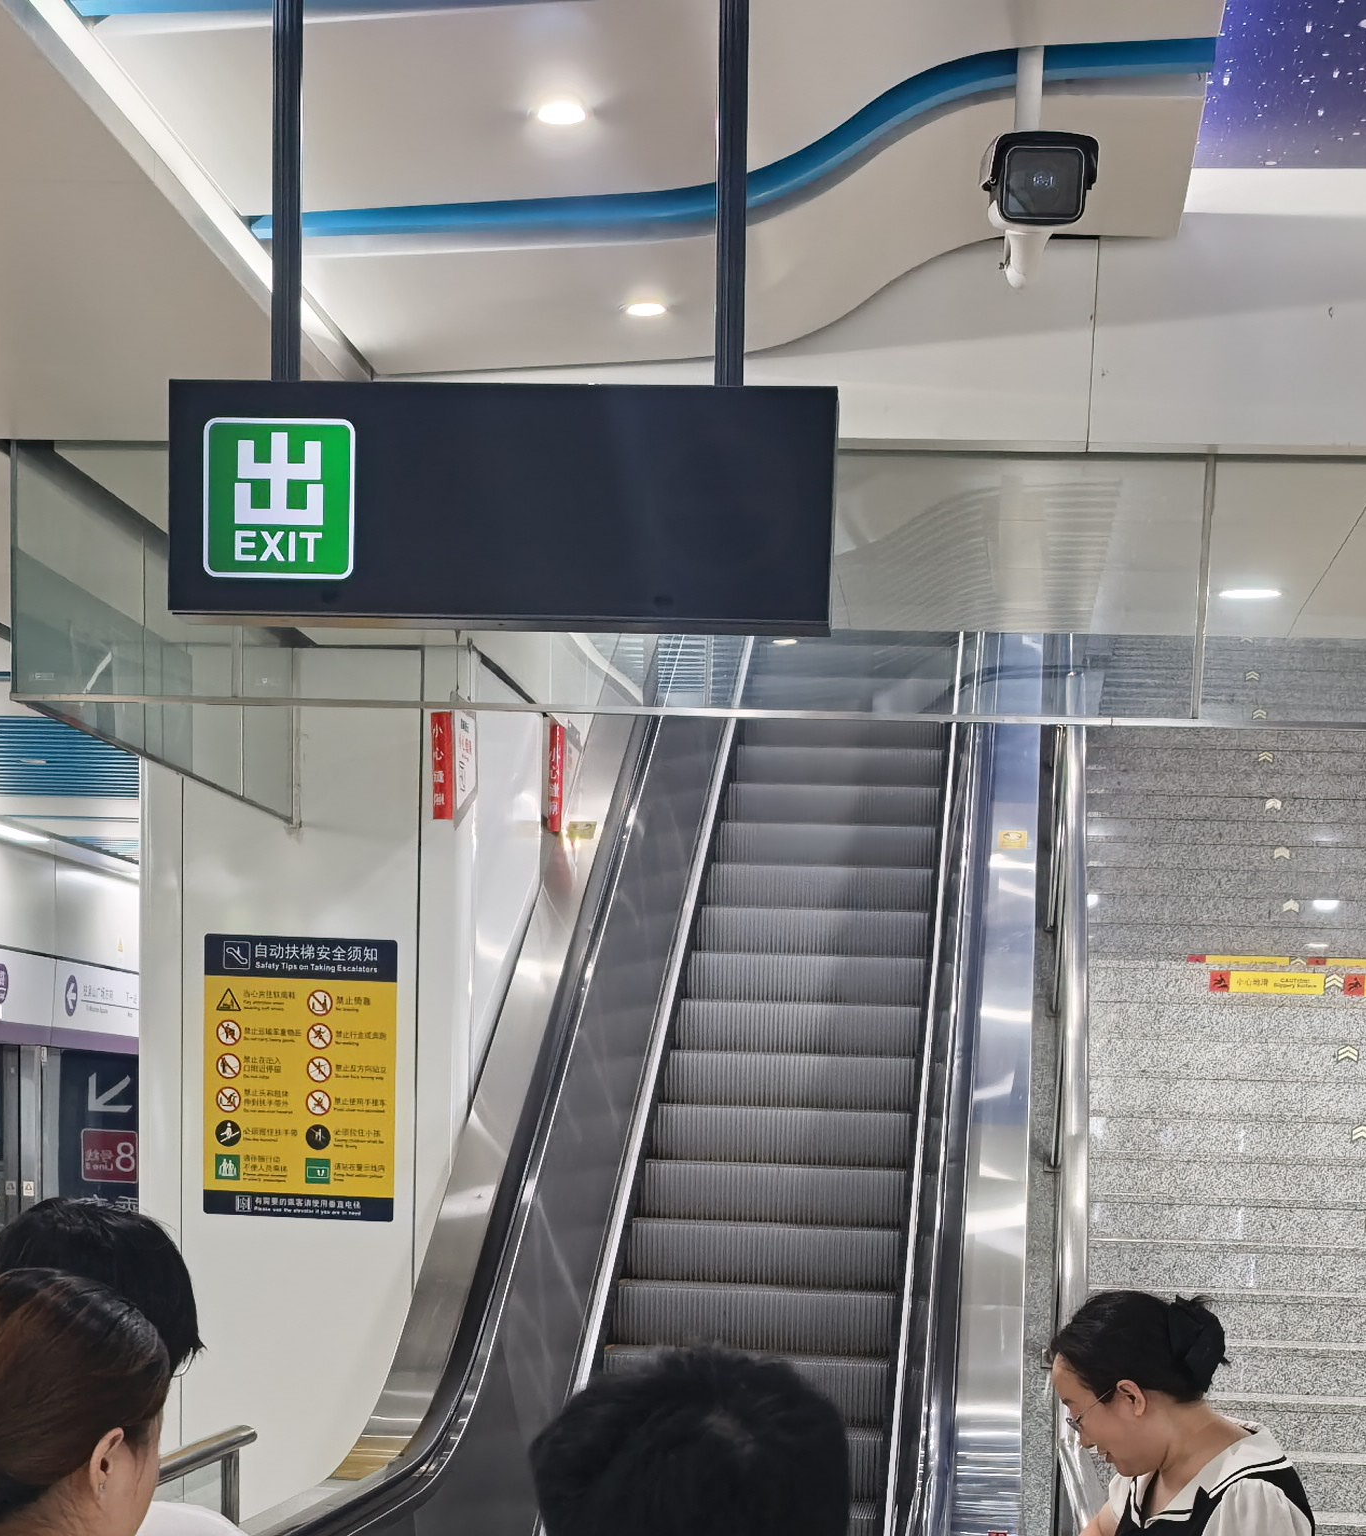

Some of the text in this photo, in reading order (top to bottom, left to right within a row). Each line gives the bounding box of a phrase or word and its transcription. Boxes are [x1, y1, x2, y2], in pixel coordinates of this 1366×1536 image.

[234, 432, 324, 526] 出
[235, 531, 322, 563] EXIT
[255, 943, 378, 963] 自动扶梯安全须知
[255, 962, 280, 971] Safety
[281, 963, 298, 971] Tips
[311, 963, 336, 973] Taking
[337, 964, 378, 973] Escalators
